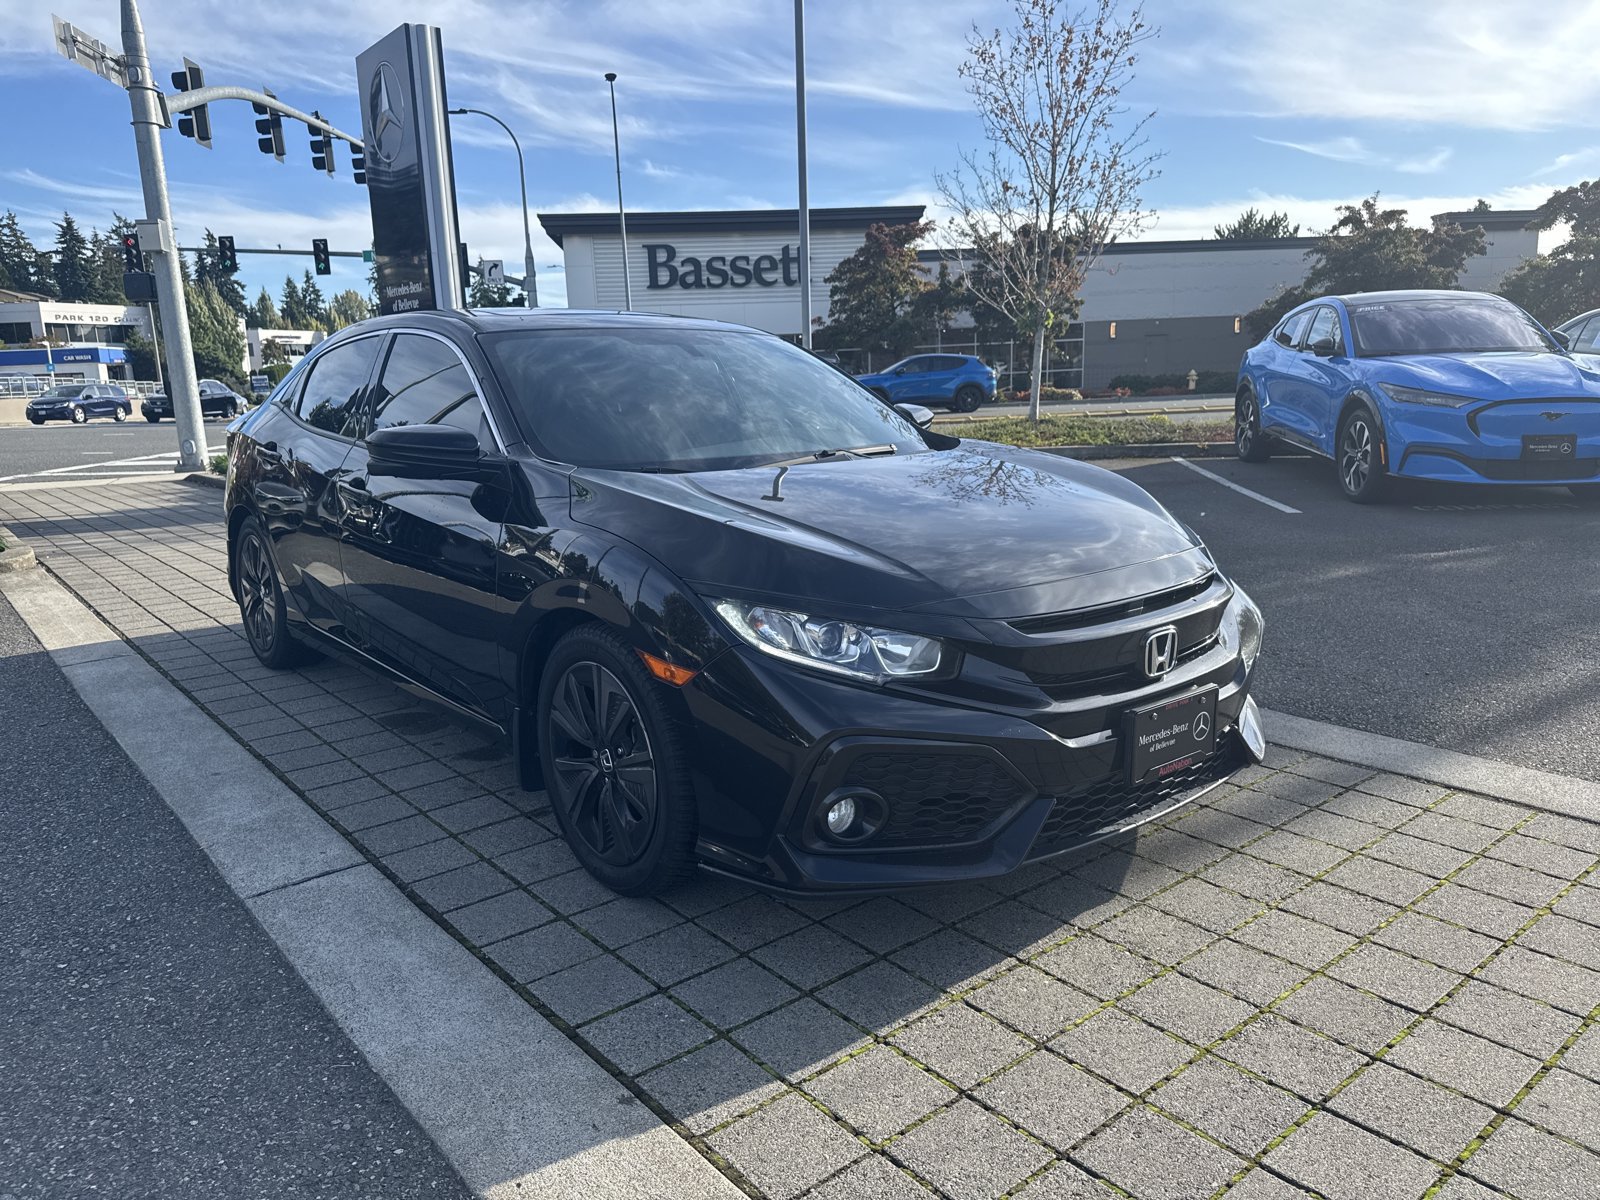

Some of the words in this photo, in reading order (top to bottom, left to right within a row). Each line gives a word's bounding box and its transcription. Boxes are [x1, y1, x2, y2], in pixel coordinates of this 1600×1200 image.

[386, 281, 422, 298] Mercedes-Benz
[392, 300, 398, 312] of
[398, 298, 419, 311] Bellevue
[55, 314, 84, 322] PARK
[1138, 722, 1189, 746] Mercedes-Benz
[1155, 738, 1176, 751] Bellevue
[1158, 757, 1193, 776] AutoNation
